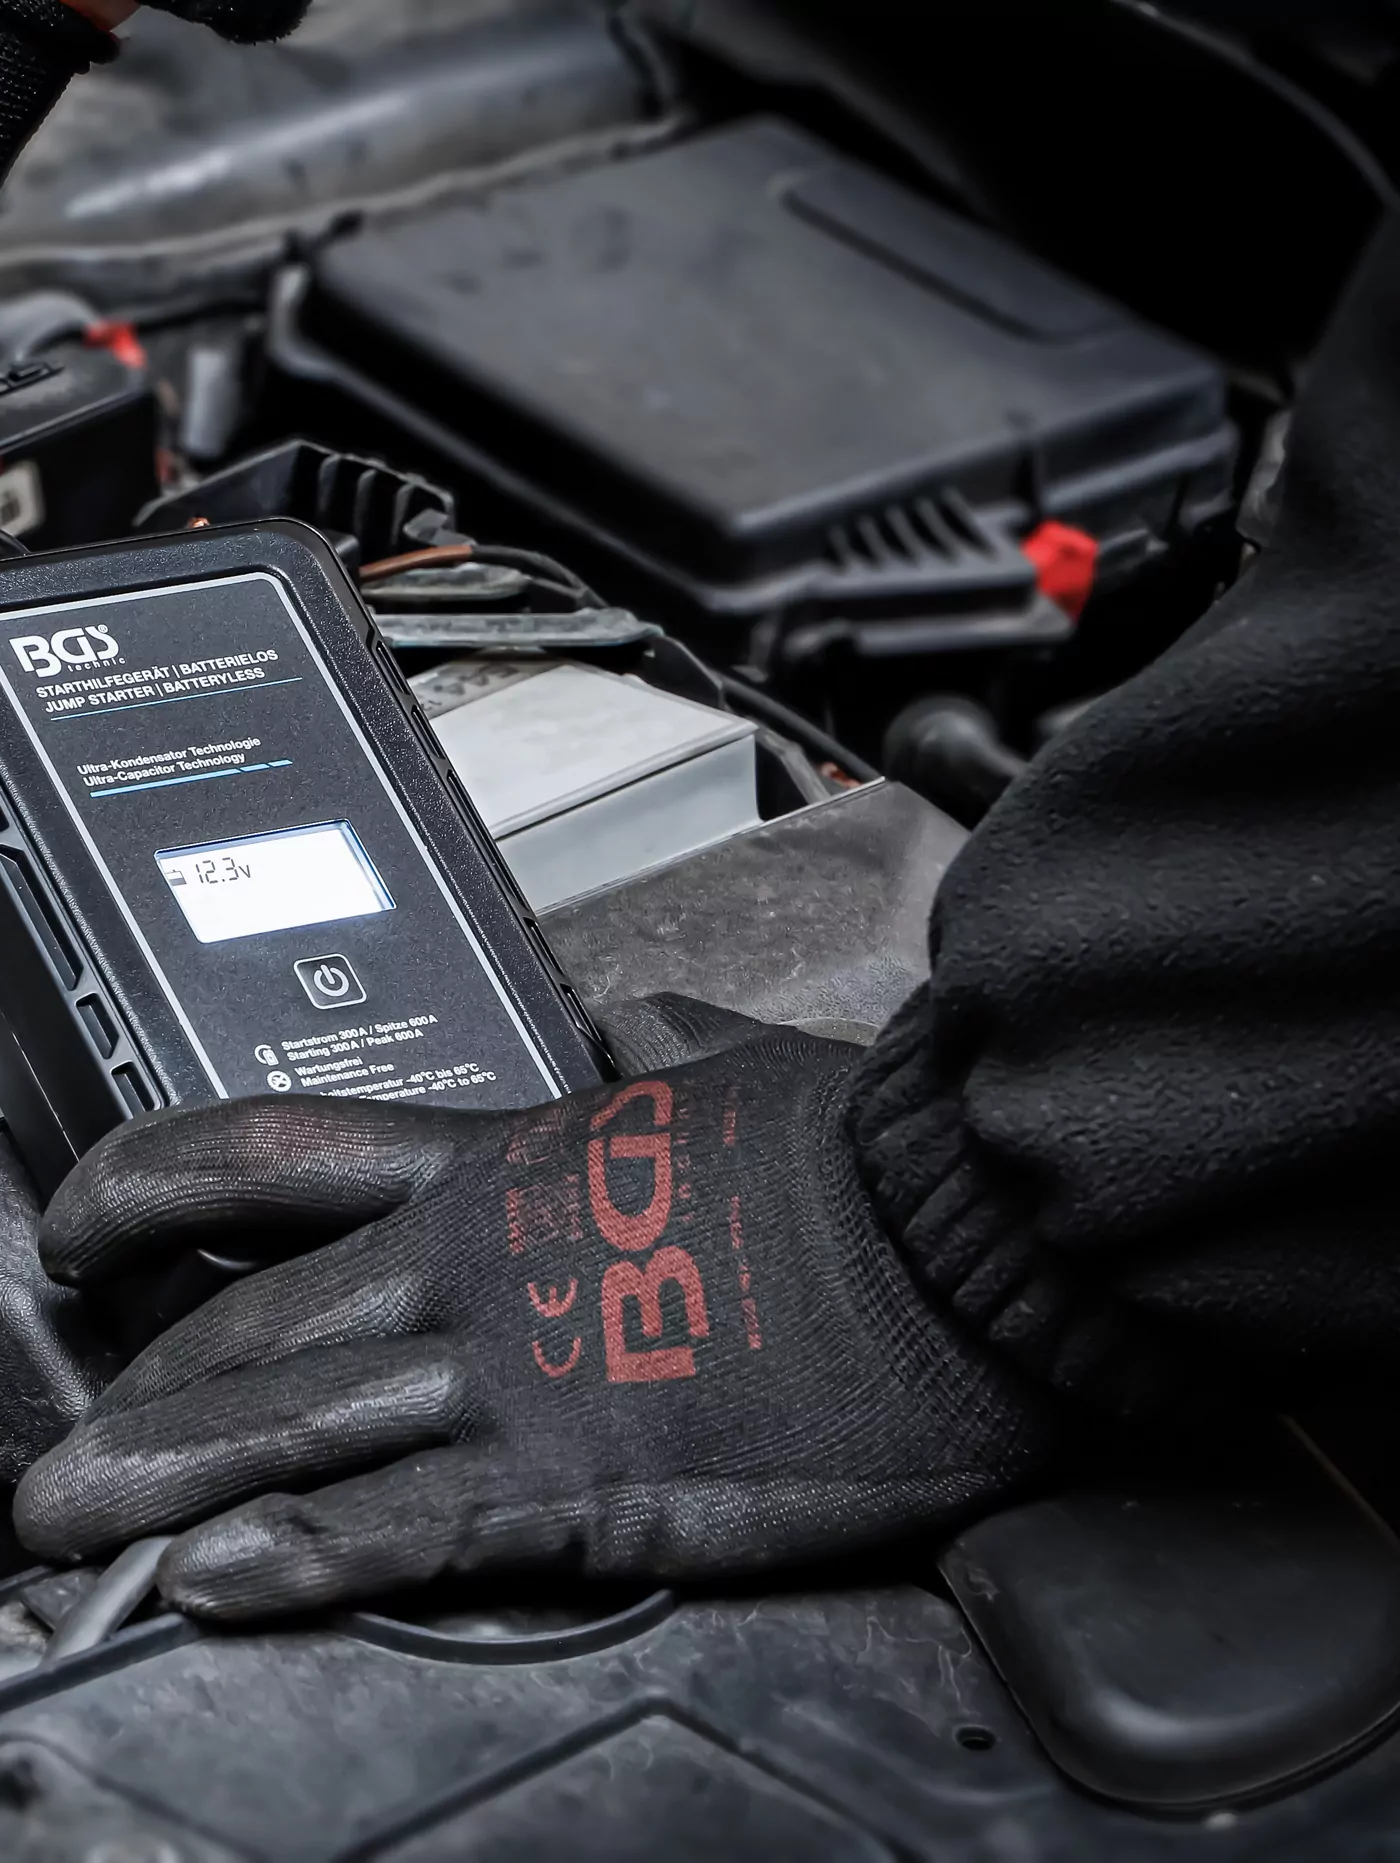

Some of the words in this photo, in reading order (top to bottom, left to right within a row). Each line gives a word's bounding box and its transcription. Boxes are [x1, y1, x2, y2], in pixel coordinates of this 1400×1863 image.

[36, 666, 169, 698] STARTHILFEGERÄT
[180, 650, 278, 675] BATTERIELOS
[67, 657, 126, 672] technic
[46, 696, 86, 713] JUMP
[88, 685, 156, 706] STARTER
[163, 668, 265, 693] BATTERYLESS
[77, 749, 188, 775] Ultra-Kondensator
[188, 737, 261, 757] Technologie
[83, 764, 175, 787] Ultra-Capacitor
[176, 752, 245, 772] Technology
[281, 1033, 338, 1051] Startstrom
[374, 1020, 408, 1034] Spitze
[287, 1047, 330, 1062] Starting
[367, 1034, 394, 1047] Peak
[294, 1056, 364, 1077] Wartungsfrei
[300, 1068, 369, 1087] Maintenance
[369, 1063, 395, 1076] Free
[435, 1068, 453, 1080] bis
[453, 1062, 480, 1076] 65°C
[457, 1077, 472, 1087] to
[471, 1071, 497, 1084] 65°C
